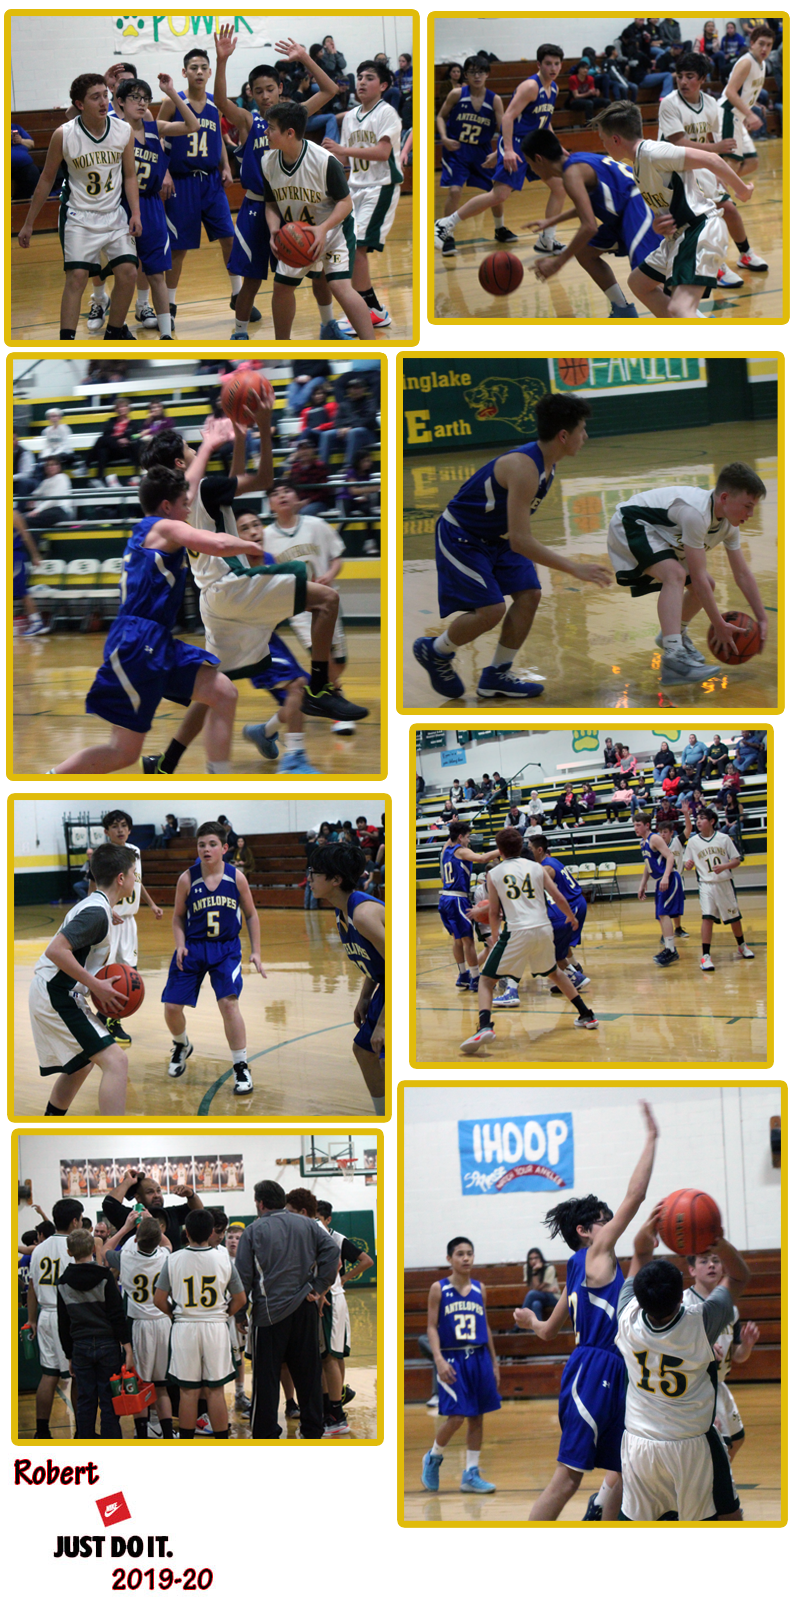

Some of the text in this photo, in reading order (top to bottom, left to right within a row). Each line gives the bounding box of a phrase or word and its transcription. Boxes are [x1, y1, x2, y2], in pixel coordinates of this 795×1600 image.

[186, 131, 208, 157] 34
[459, 123, 482, 145] 22
[86, 169, 114, 196] 34
[404, 409, 472, 444] Earth
[503, 872, 536, 900] 34
[192, 895, 237, 913] ANTELOPES
[206, 911, 220, 938] 5
[38, 1256, 60, 1286] 21
[183, 1275, 218, 1308] 15
[444, 1301, 484, 1316] ANTELOPES
[454, 1314, 476, 1340] 23
[633, 1350, 688, 1398] 15
